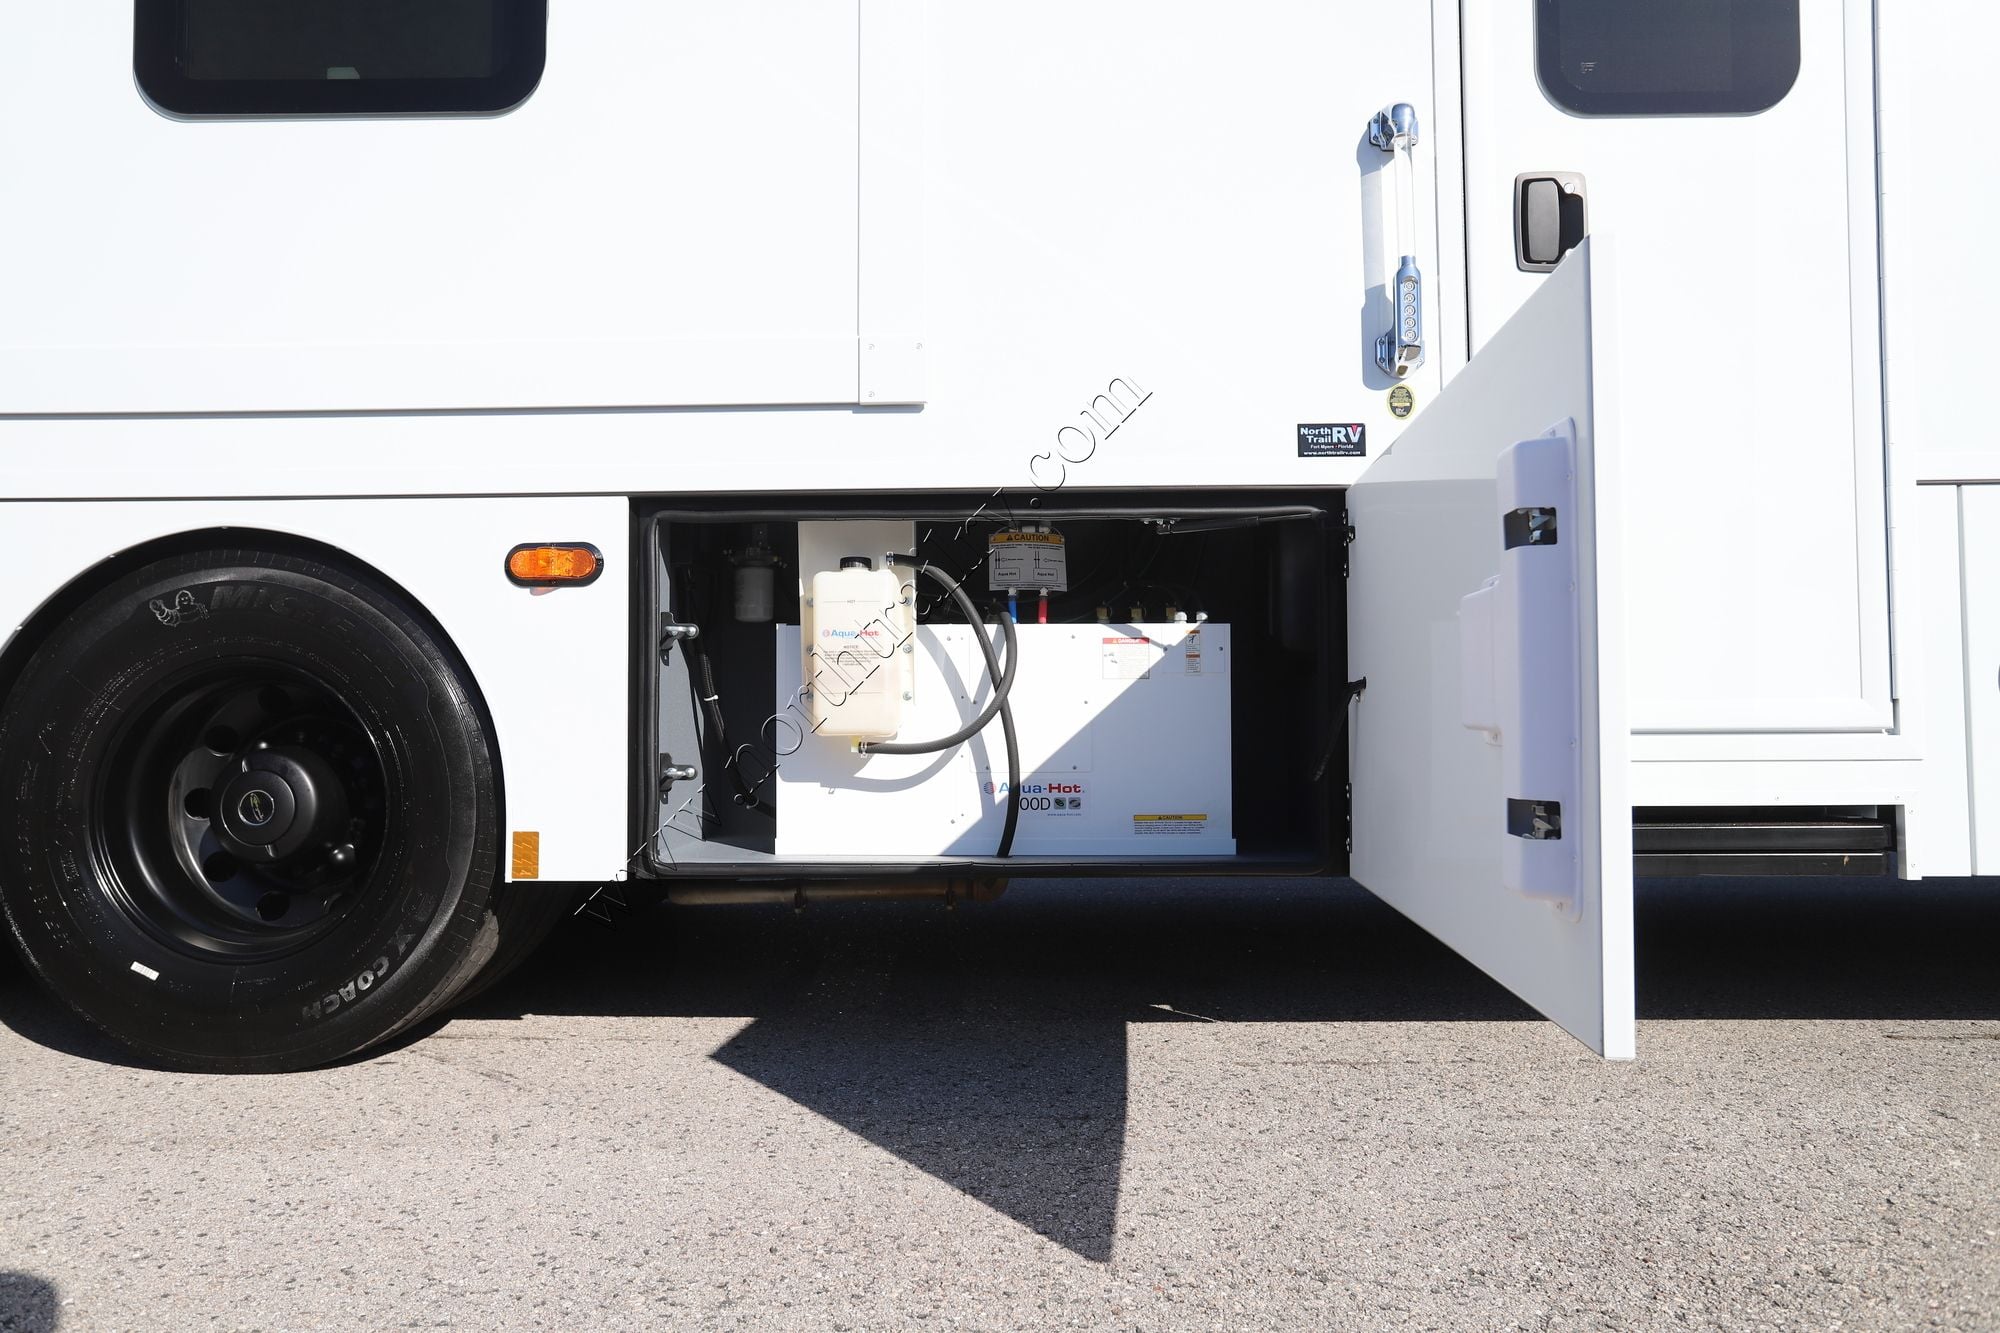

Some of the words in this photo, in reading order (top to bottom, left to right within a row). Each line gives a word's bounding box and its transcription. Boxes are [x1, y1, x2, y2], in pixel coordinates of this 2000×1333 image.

[1300, 426, 1331, 435] North
[1332, 425, 1362, 443] RV
[1306, 435, 1331, 443] Trail
[999, 782, 1081, 794] Aua-Hot
[1020, 797, 1051, 811] 00D
